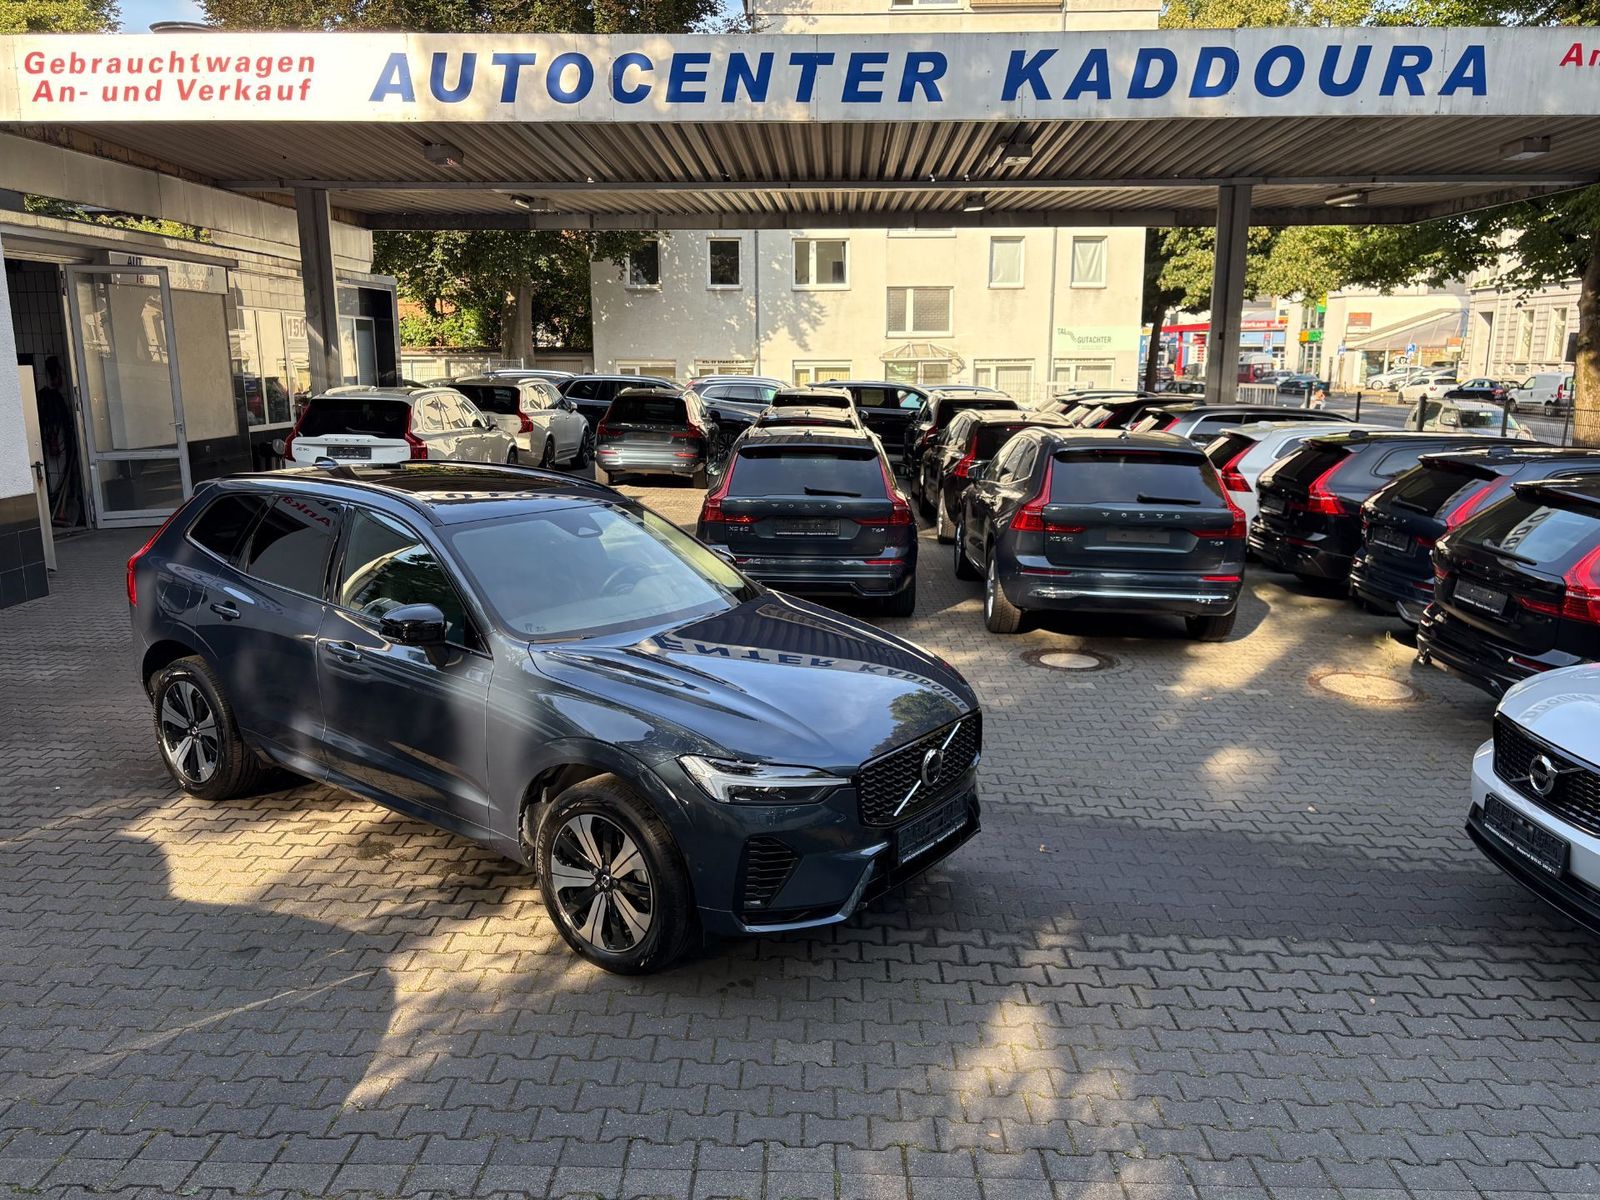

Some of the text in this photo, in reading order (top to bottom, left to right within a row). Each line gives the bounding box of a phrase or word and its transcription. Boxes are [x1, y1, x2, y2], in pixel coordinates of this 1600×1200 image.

[24, 51, 315, 78] Gebrauchtwagen
[368, 44, 1488, 105] AUTOCENTER KADDOURA
[32, 78, 311, 102] An- und Verkauf
[288, 318, 306, 338] 150
